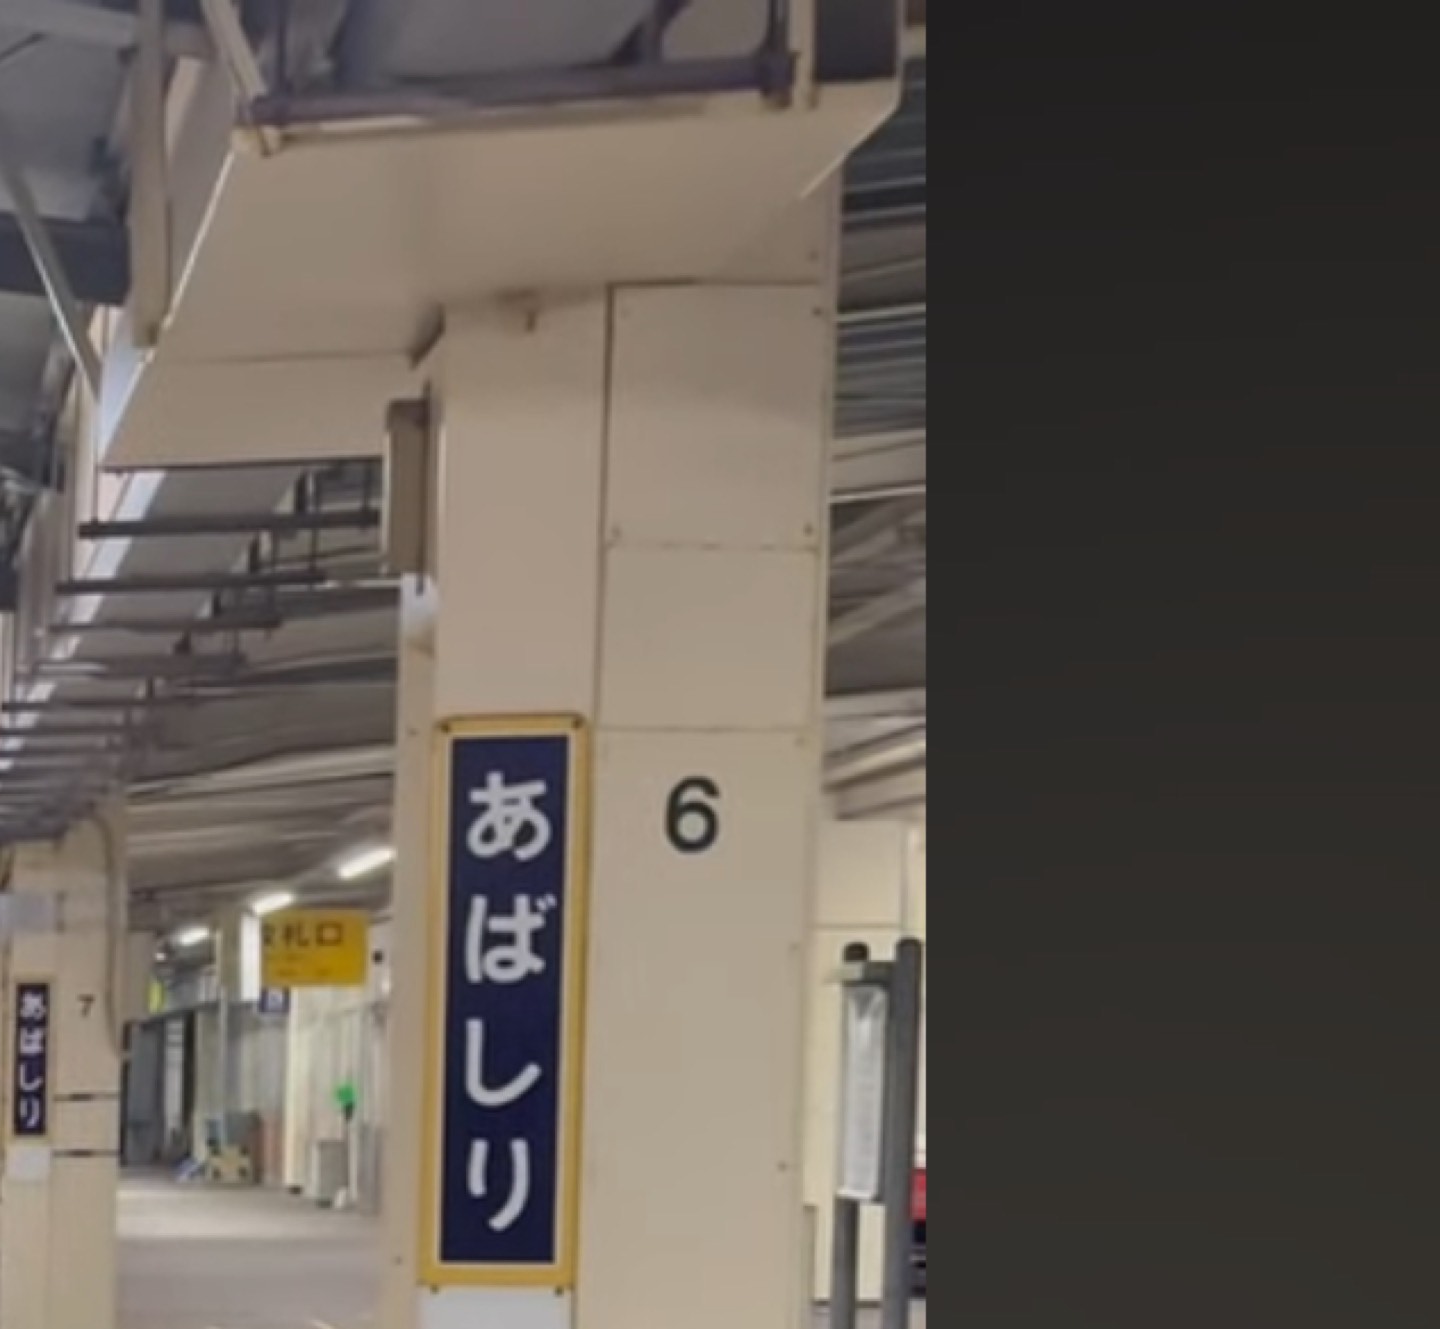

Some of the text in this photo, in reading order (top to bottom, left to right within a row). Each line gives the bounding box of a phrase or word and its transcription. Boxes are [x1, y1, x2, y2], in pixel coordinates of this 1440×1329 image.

[665, 776, 720, 853] 6
[77, 994, 95, 1016] 7
[464, 771, 557, 1232] あばしり
[19, 990, 44, 1128] あばしり
